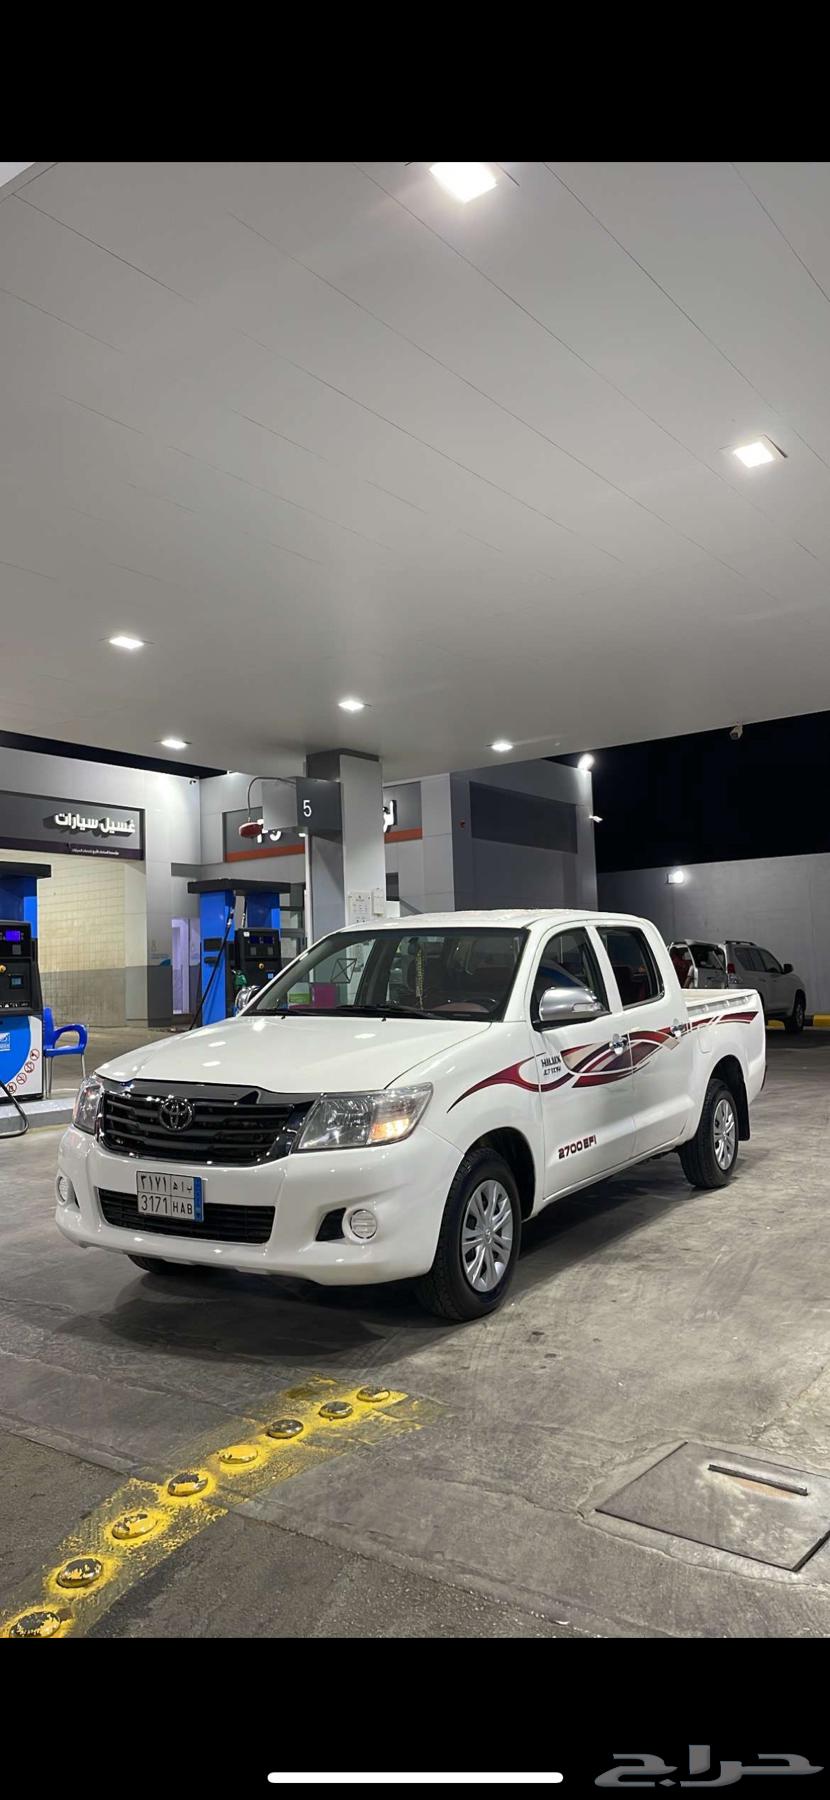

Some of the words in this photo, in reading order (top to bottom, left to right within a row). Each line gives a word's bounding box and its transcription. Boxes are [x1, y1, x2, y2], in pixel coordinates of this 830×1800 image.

[303, 799, 312, 818] 5
[54, 812, 99, 831] سيارات
[100, 817, 136, 834] غسيل
[558, 1144, 583, 1160] 2700
[141, 1194, 168, 1214] 3171
[172, 1201, 193, 1215] HAB
